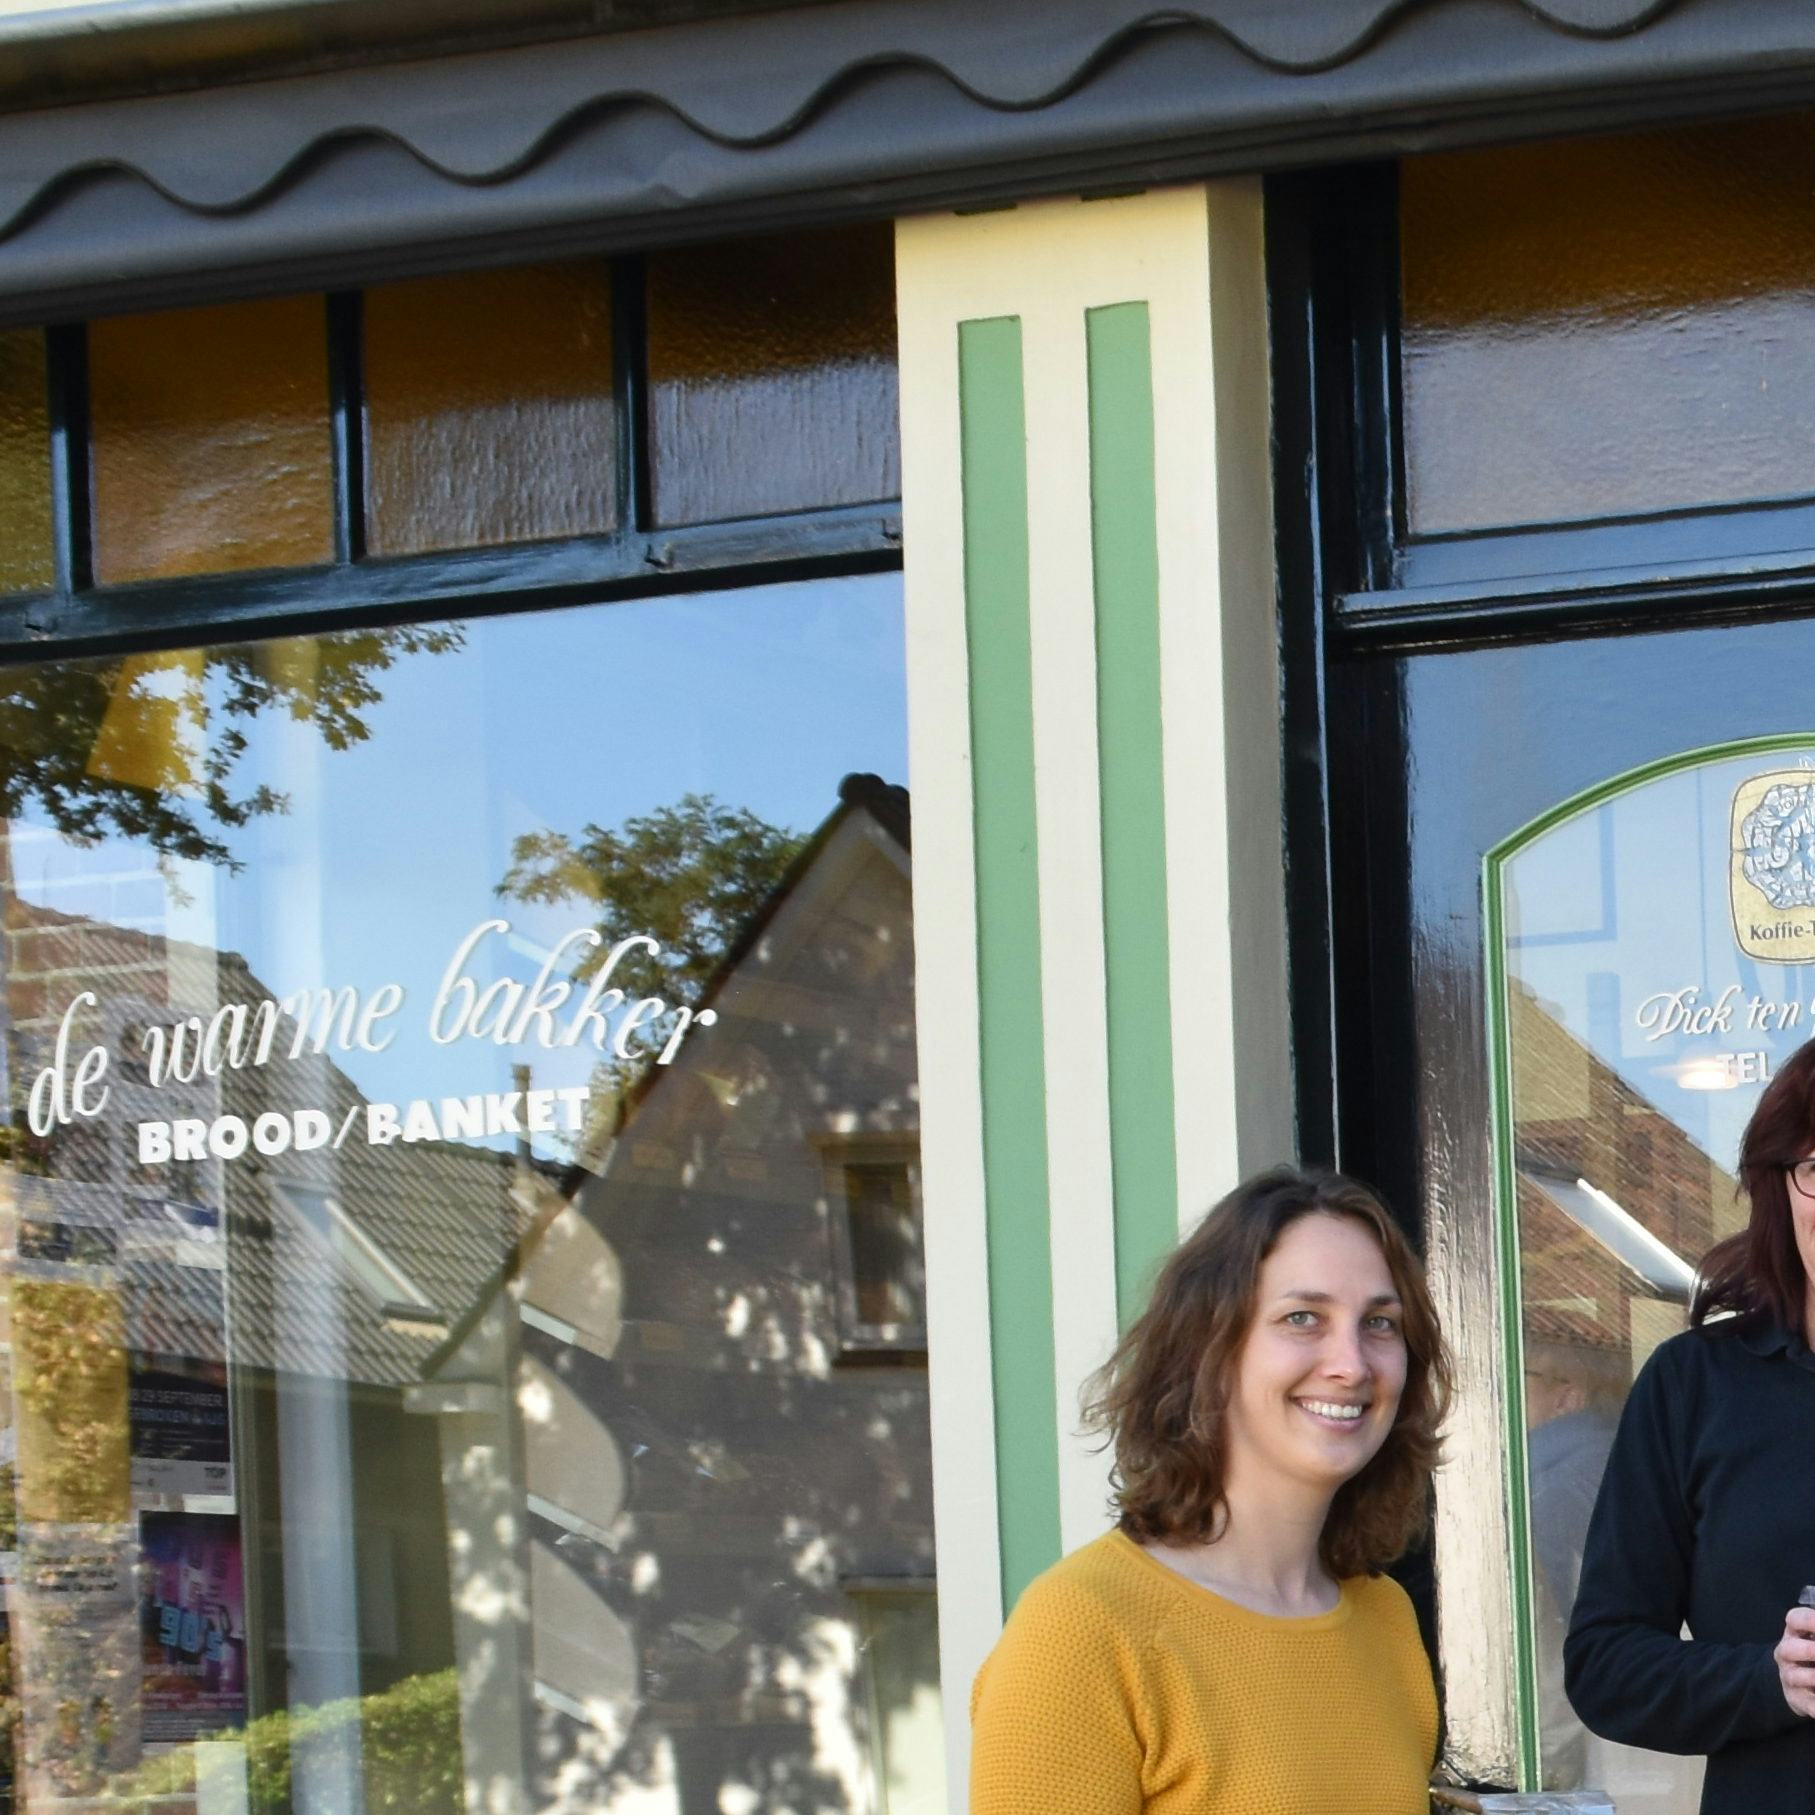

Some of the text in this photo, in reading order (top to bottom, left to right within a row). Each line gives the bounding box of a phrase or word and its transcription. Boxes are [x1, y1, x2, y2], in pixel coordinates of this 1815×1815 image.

[27, 919, 718, 1138] de warme bakker
[1636, 987, 1735, 1041] Dick
[1746, 996, 1800, 1032] ten
[137, 1086, 590, 1165] BROOD/BANKET
